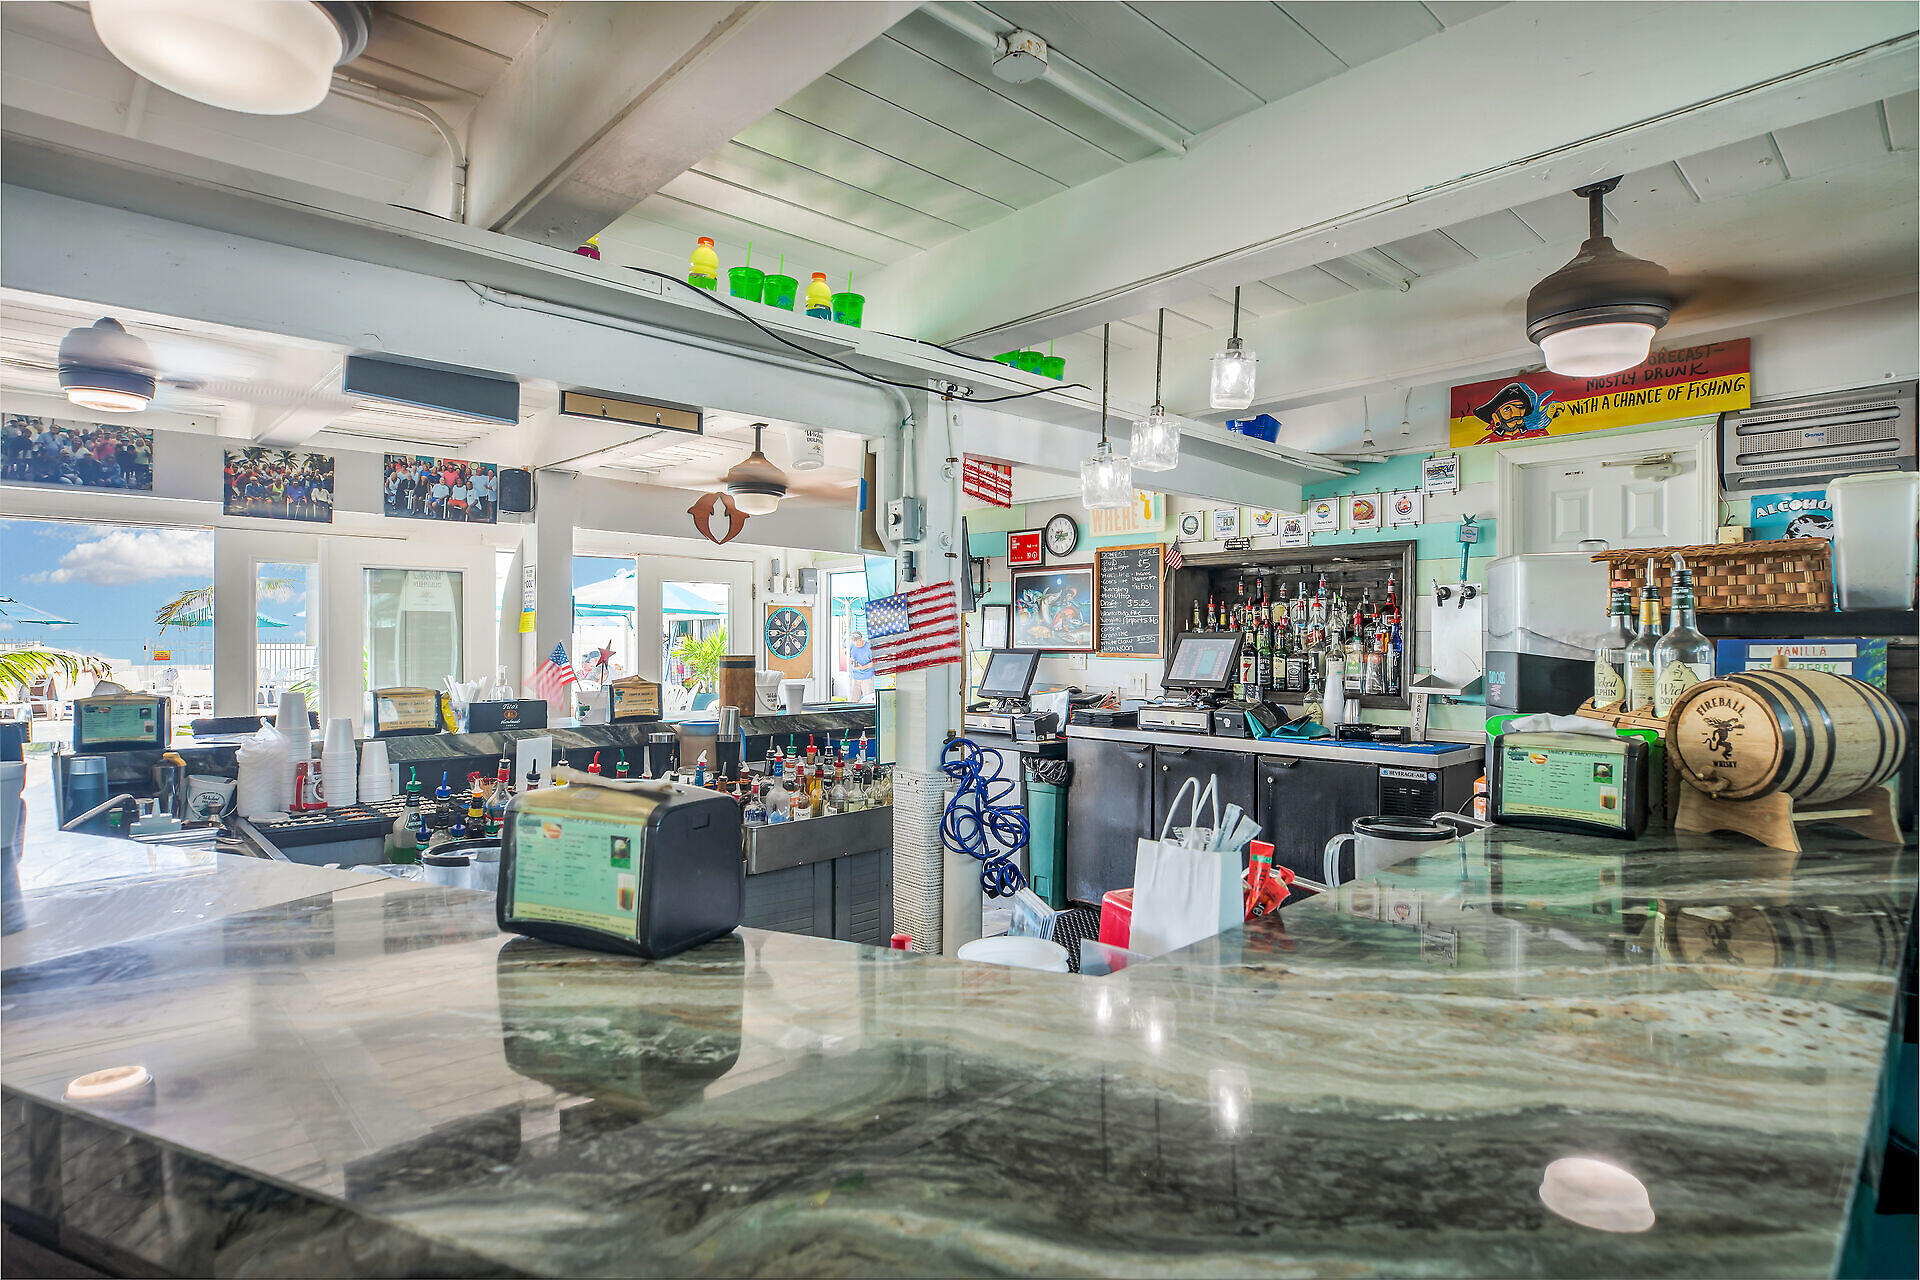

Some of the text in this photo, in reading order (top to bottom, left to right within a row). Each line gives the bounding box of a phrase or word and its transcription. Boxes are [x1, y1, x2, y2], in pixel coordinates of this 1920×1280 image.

[1587, 362, 1709, 392] MOSTLY DRUNK
[1601, 396, 1611, 410] A
[1613, 388, 1663, 408] CHANCE
[1667, 386, 1684, 401] OF
[1756, 498, 1833, 519] ALCOHO
[1777, 646, 1827, 657] VANILLA
[1243, 661, 1252, 682] 7
[1696, 697, 1745, 718] FIREBALL
[1713, 760, 1738, 769] WHISKY
